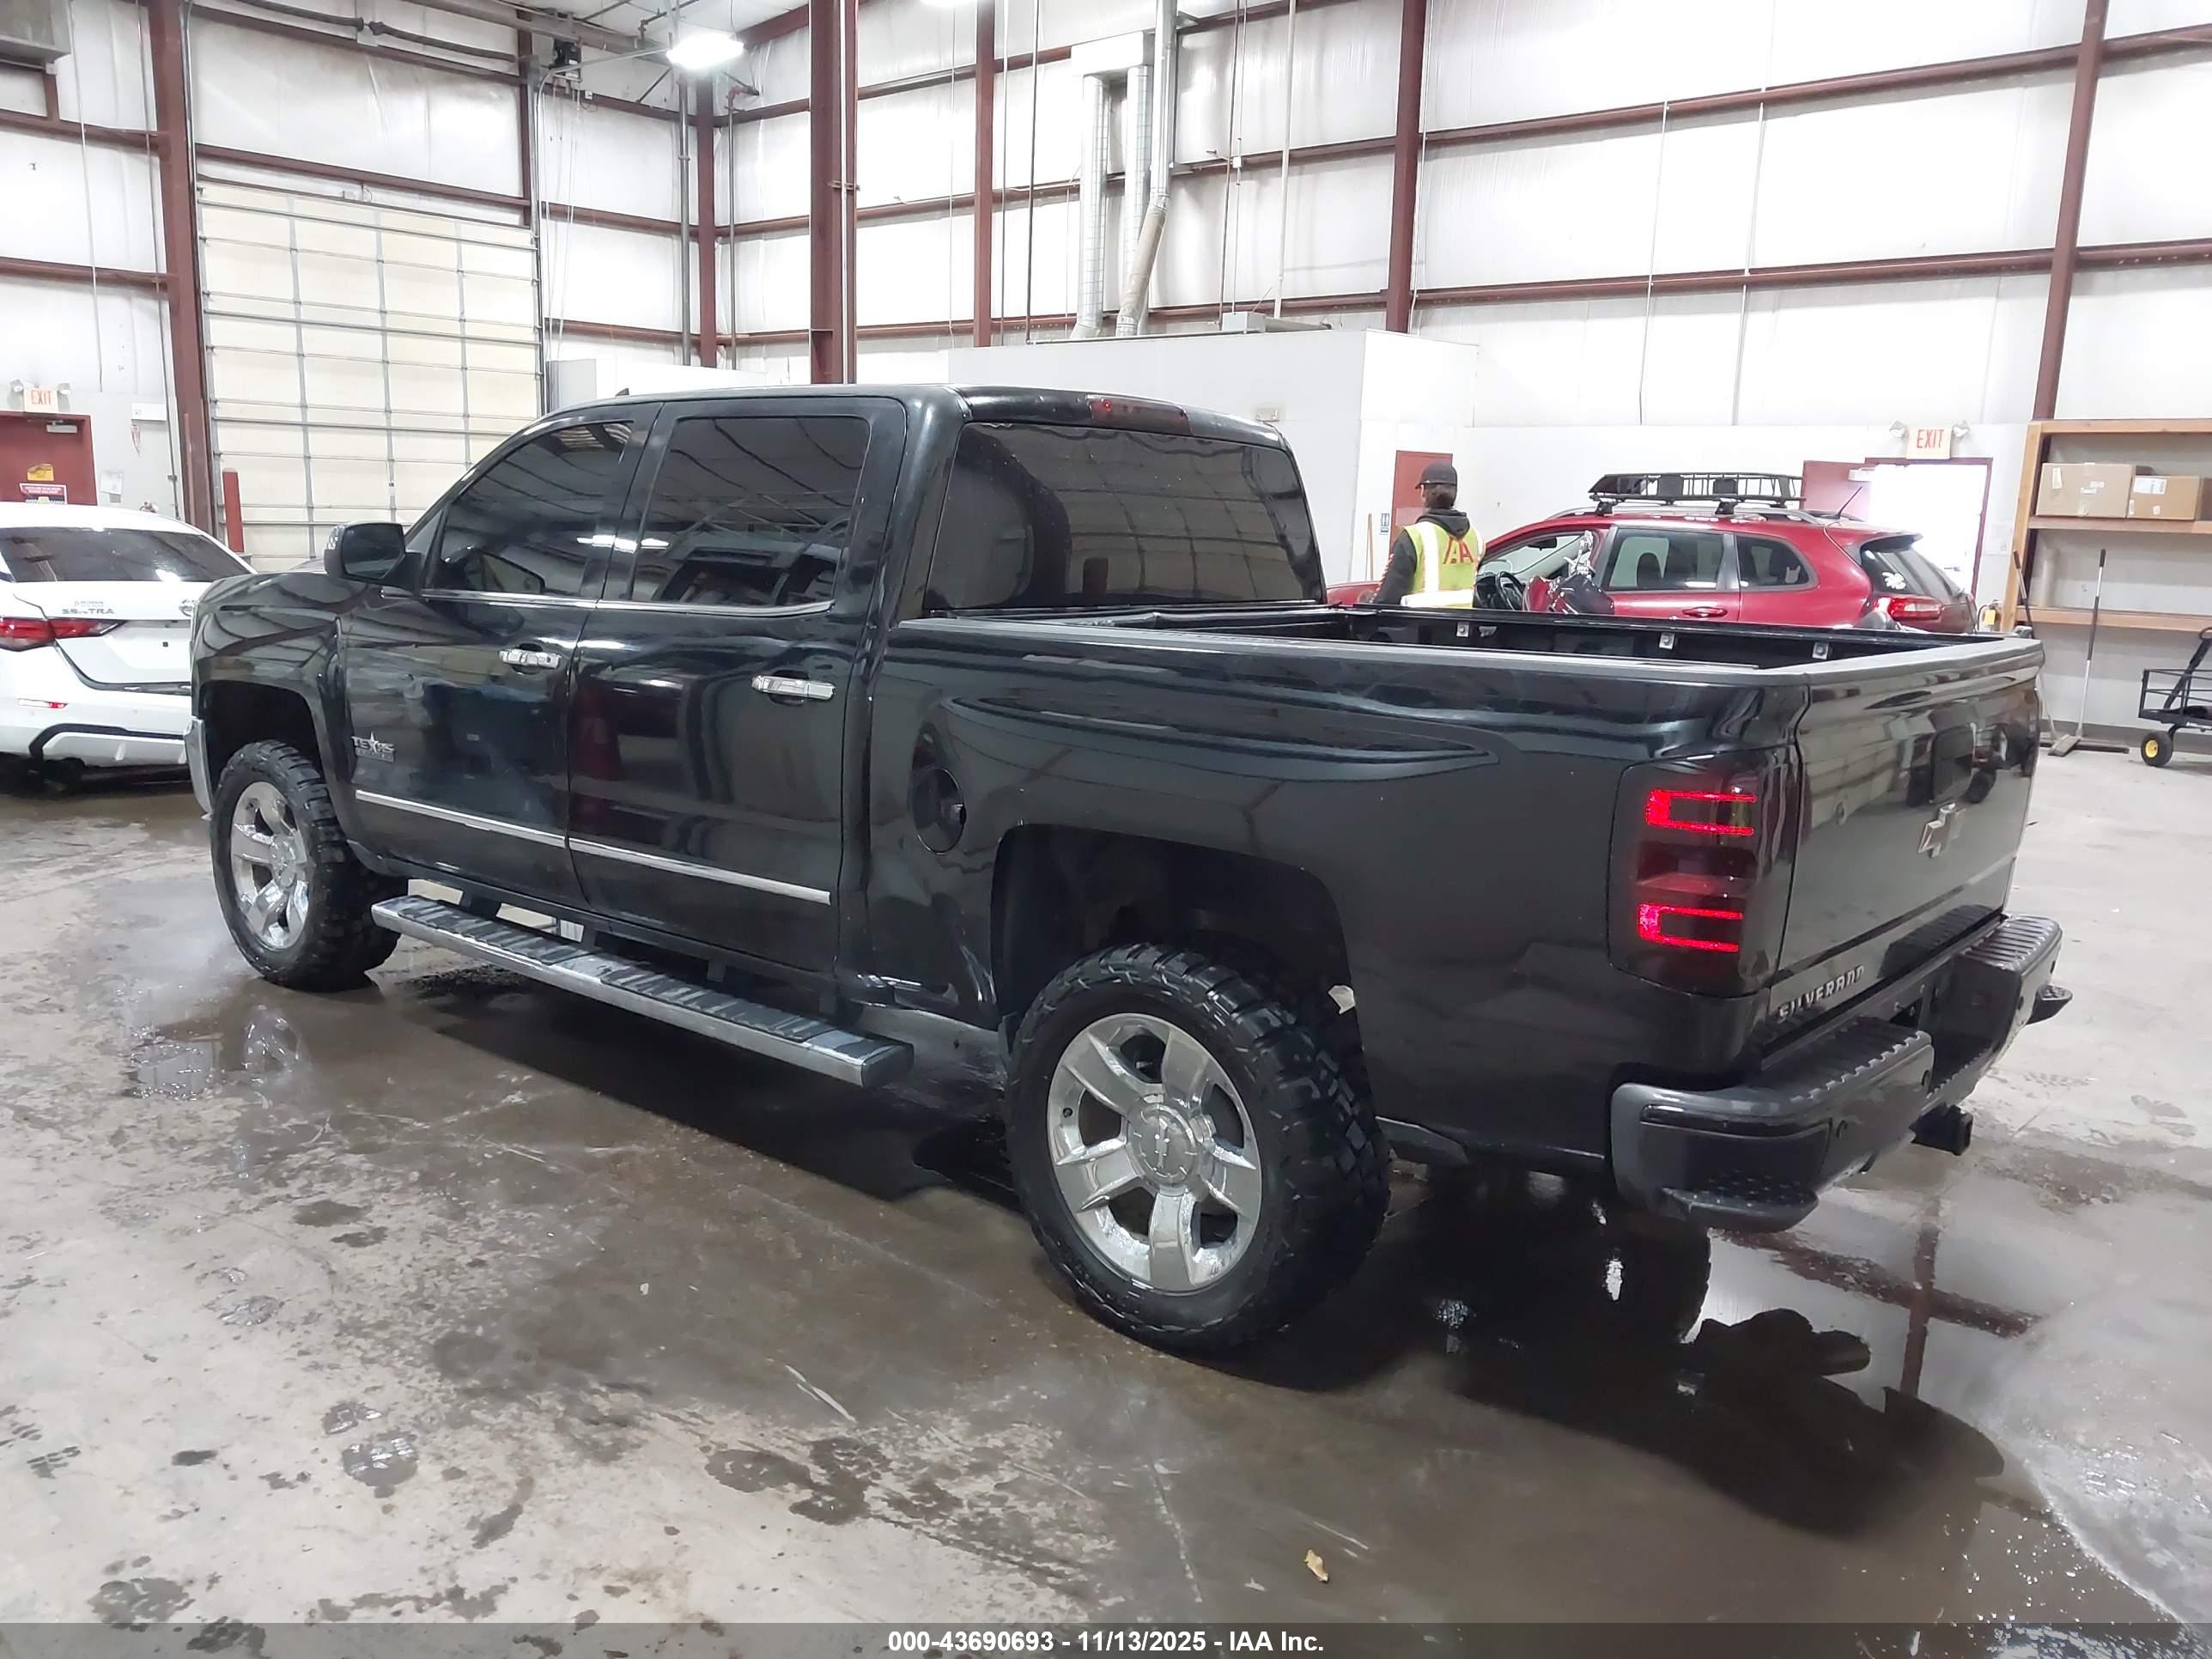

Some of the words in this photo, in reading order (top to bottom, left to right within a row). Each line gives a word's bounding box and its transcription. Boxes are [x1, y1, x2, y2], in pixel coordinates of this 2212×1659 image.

[30, 389, 52, 405] EXIT
[1916, 428, 1945, 449] EXIT
[350, 732, 395, 754] TEXAS
